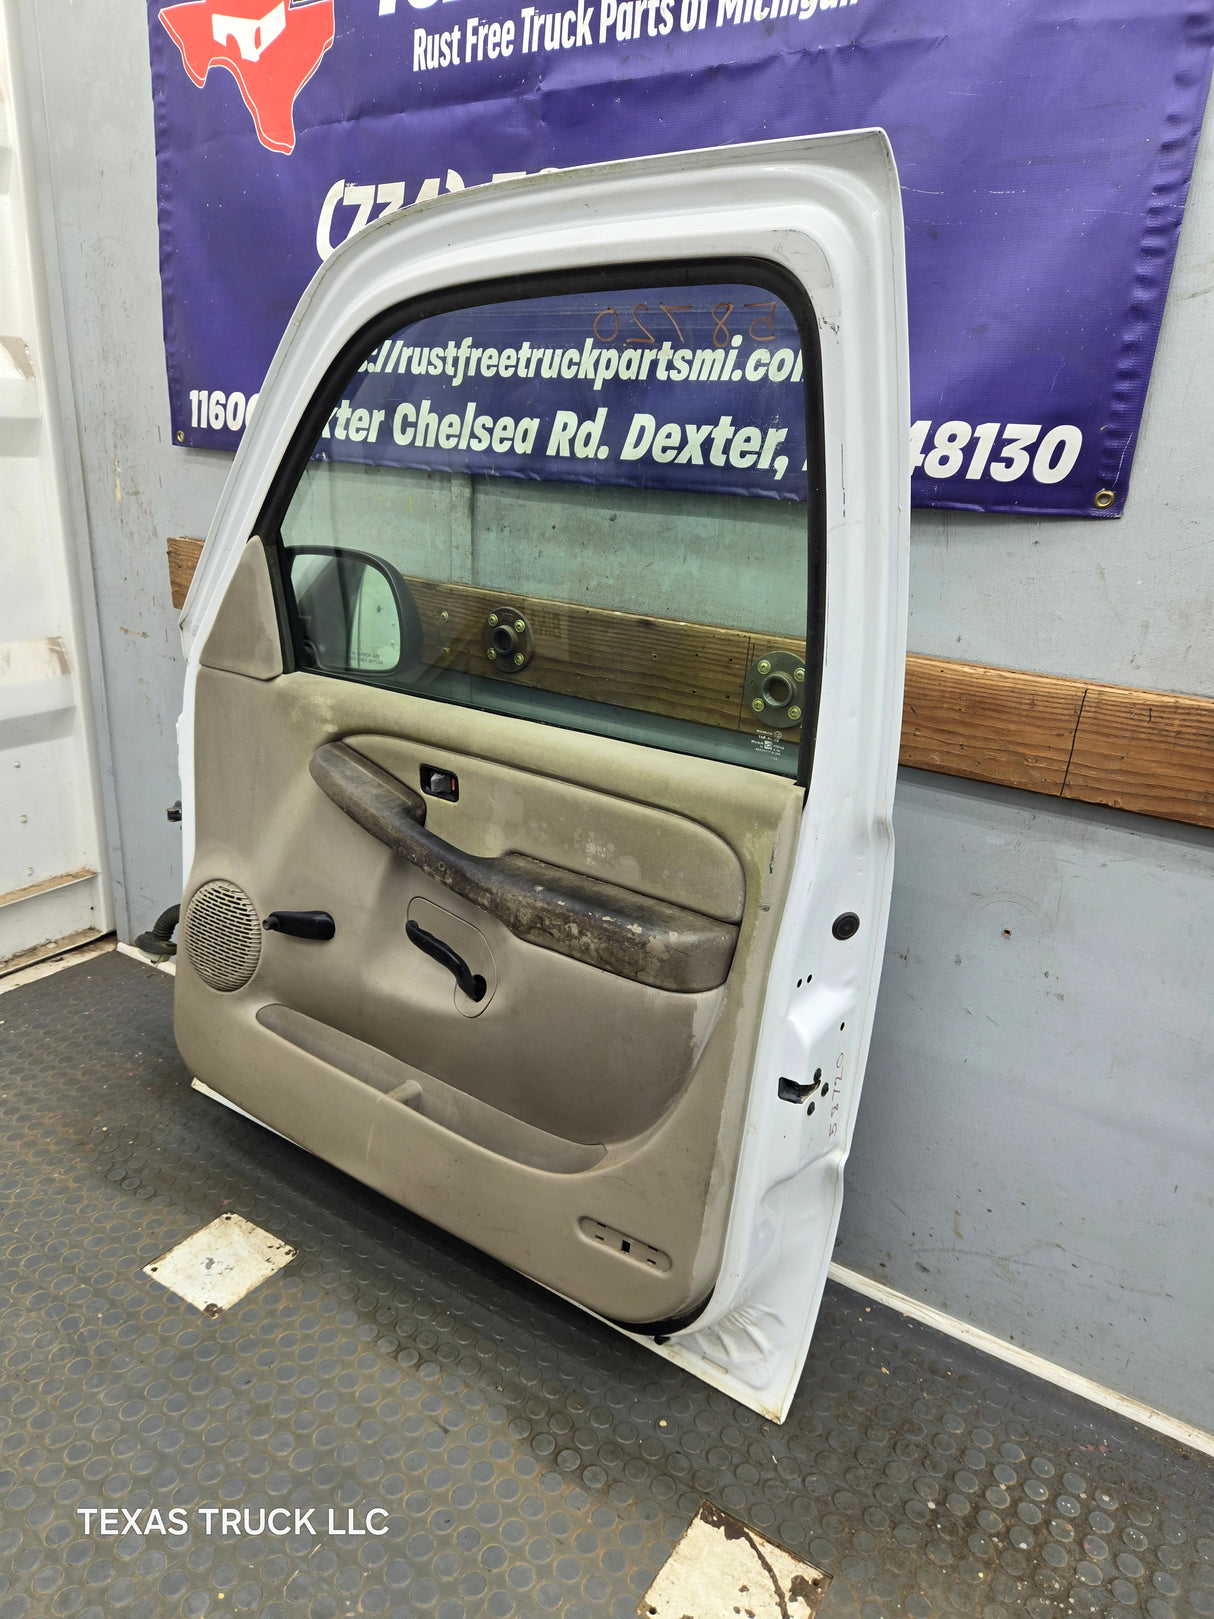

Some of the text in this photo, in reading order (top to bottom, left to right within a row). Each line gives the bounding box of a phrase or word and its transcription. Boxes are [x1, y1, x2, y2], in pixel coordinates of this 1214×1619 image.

[413, 24, 461, 72] Rust
[465, 17, 515, 63] Free
[521, 0, 595, 53] Truck
[599, 0, 674, 43] Parts
[715, 0, 858, 27] Micg
[357, 335, 804, 391] ://rustfreetruckpartsmi.co
[392, 400, 540, 455] Chelsea
[545, 407, 610, 460] Rd.
[619, 413, 789, 480] Dexter,
